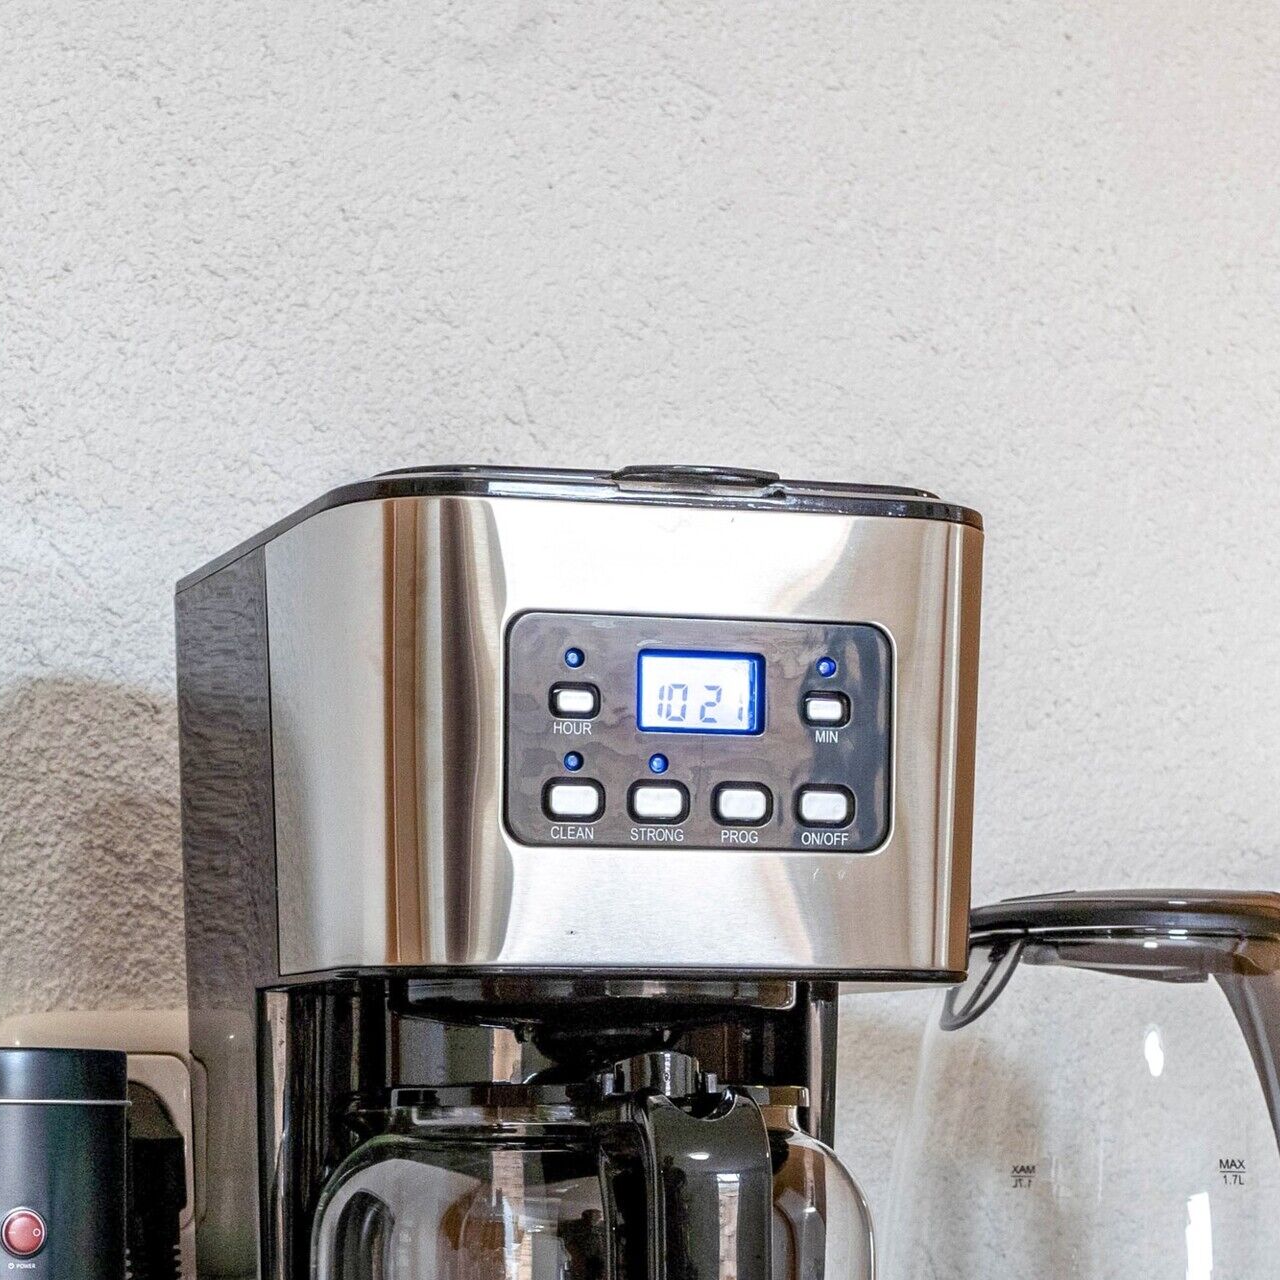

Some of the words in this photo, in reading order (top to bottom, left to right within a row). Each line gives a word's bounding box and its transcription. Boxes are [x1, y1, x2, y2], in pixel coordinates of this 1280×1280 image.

[553, 721, 592, 735] HOUR
[815, 730, 838, 743] MIN
[550, 825, 594, 840] CLEAN
[630, 827, 684, 842] STRONG
[721, 830, 759, 844] PROG
[801, 831, 849, 846] ON/OFF
[1219, 1159, 1245, 1169] MAX
[1223, 1174, 1245, 1185] 1.7L
